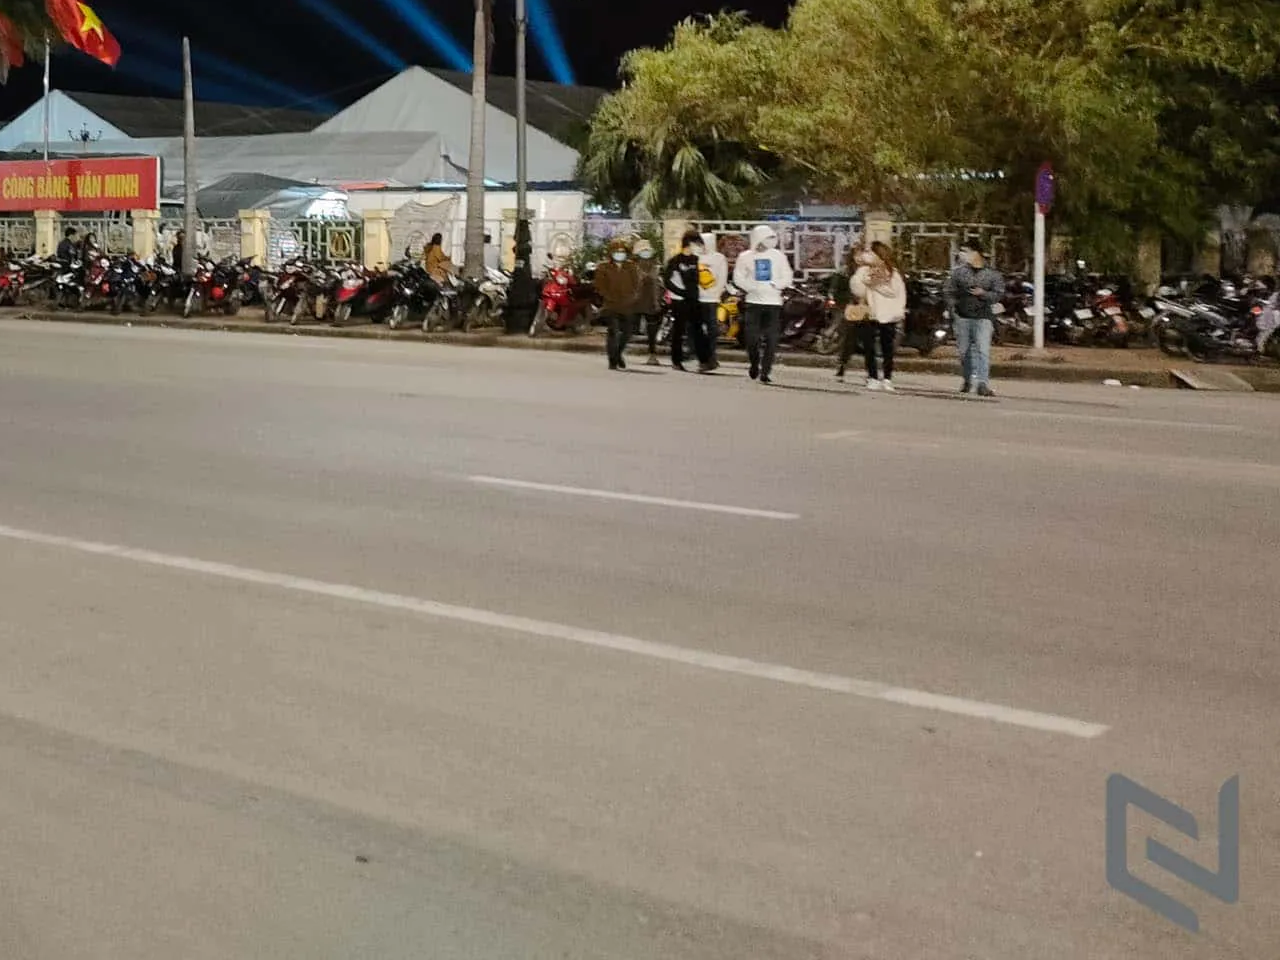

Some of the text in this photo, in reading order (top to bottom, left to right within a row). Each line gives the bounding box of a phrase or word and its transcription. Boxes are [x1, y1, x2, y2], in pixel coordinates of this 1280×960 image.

[3, 172, 35, 199] CÔNG
[76, 171, 102, 198] VĂN
[105, 173, 140, 198] MINH
